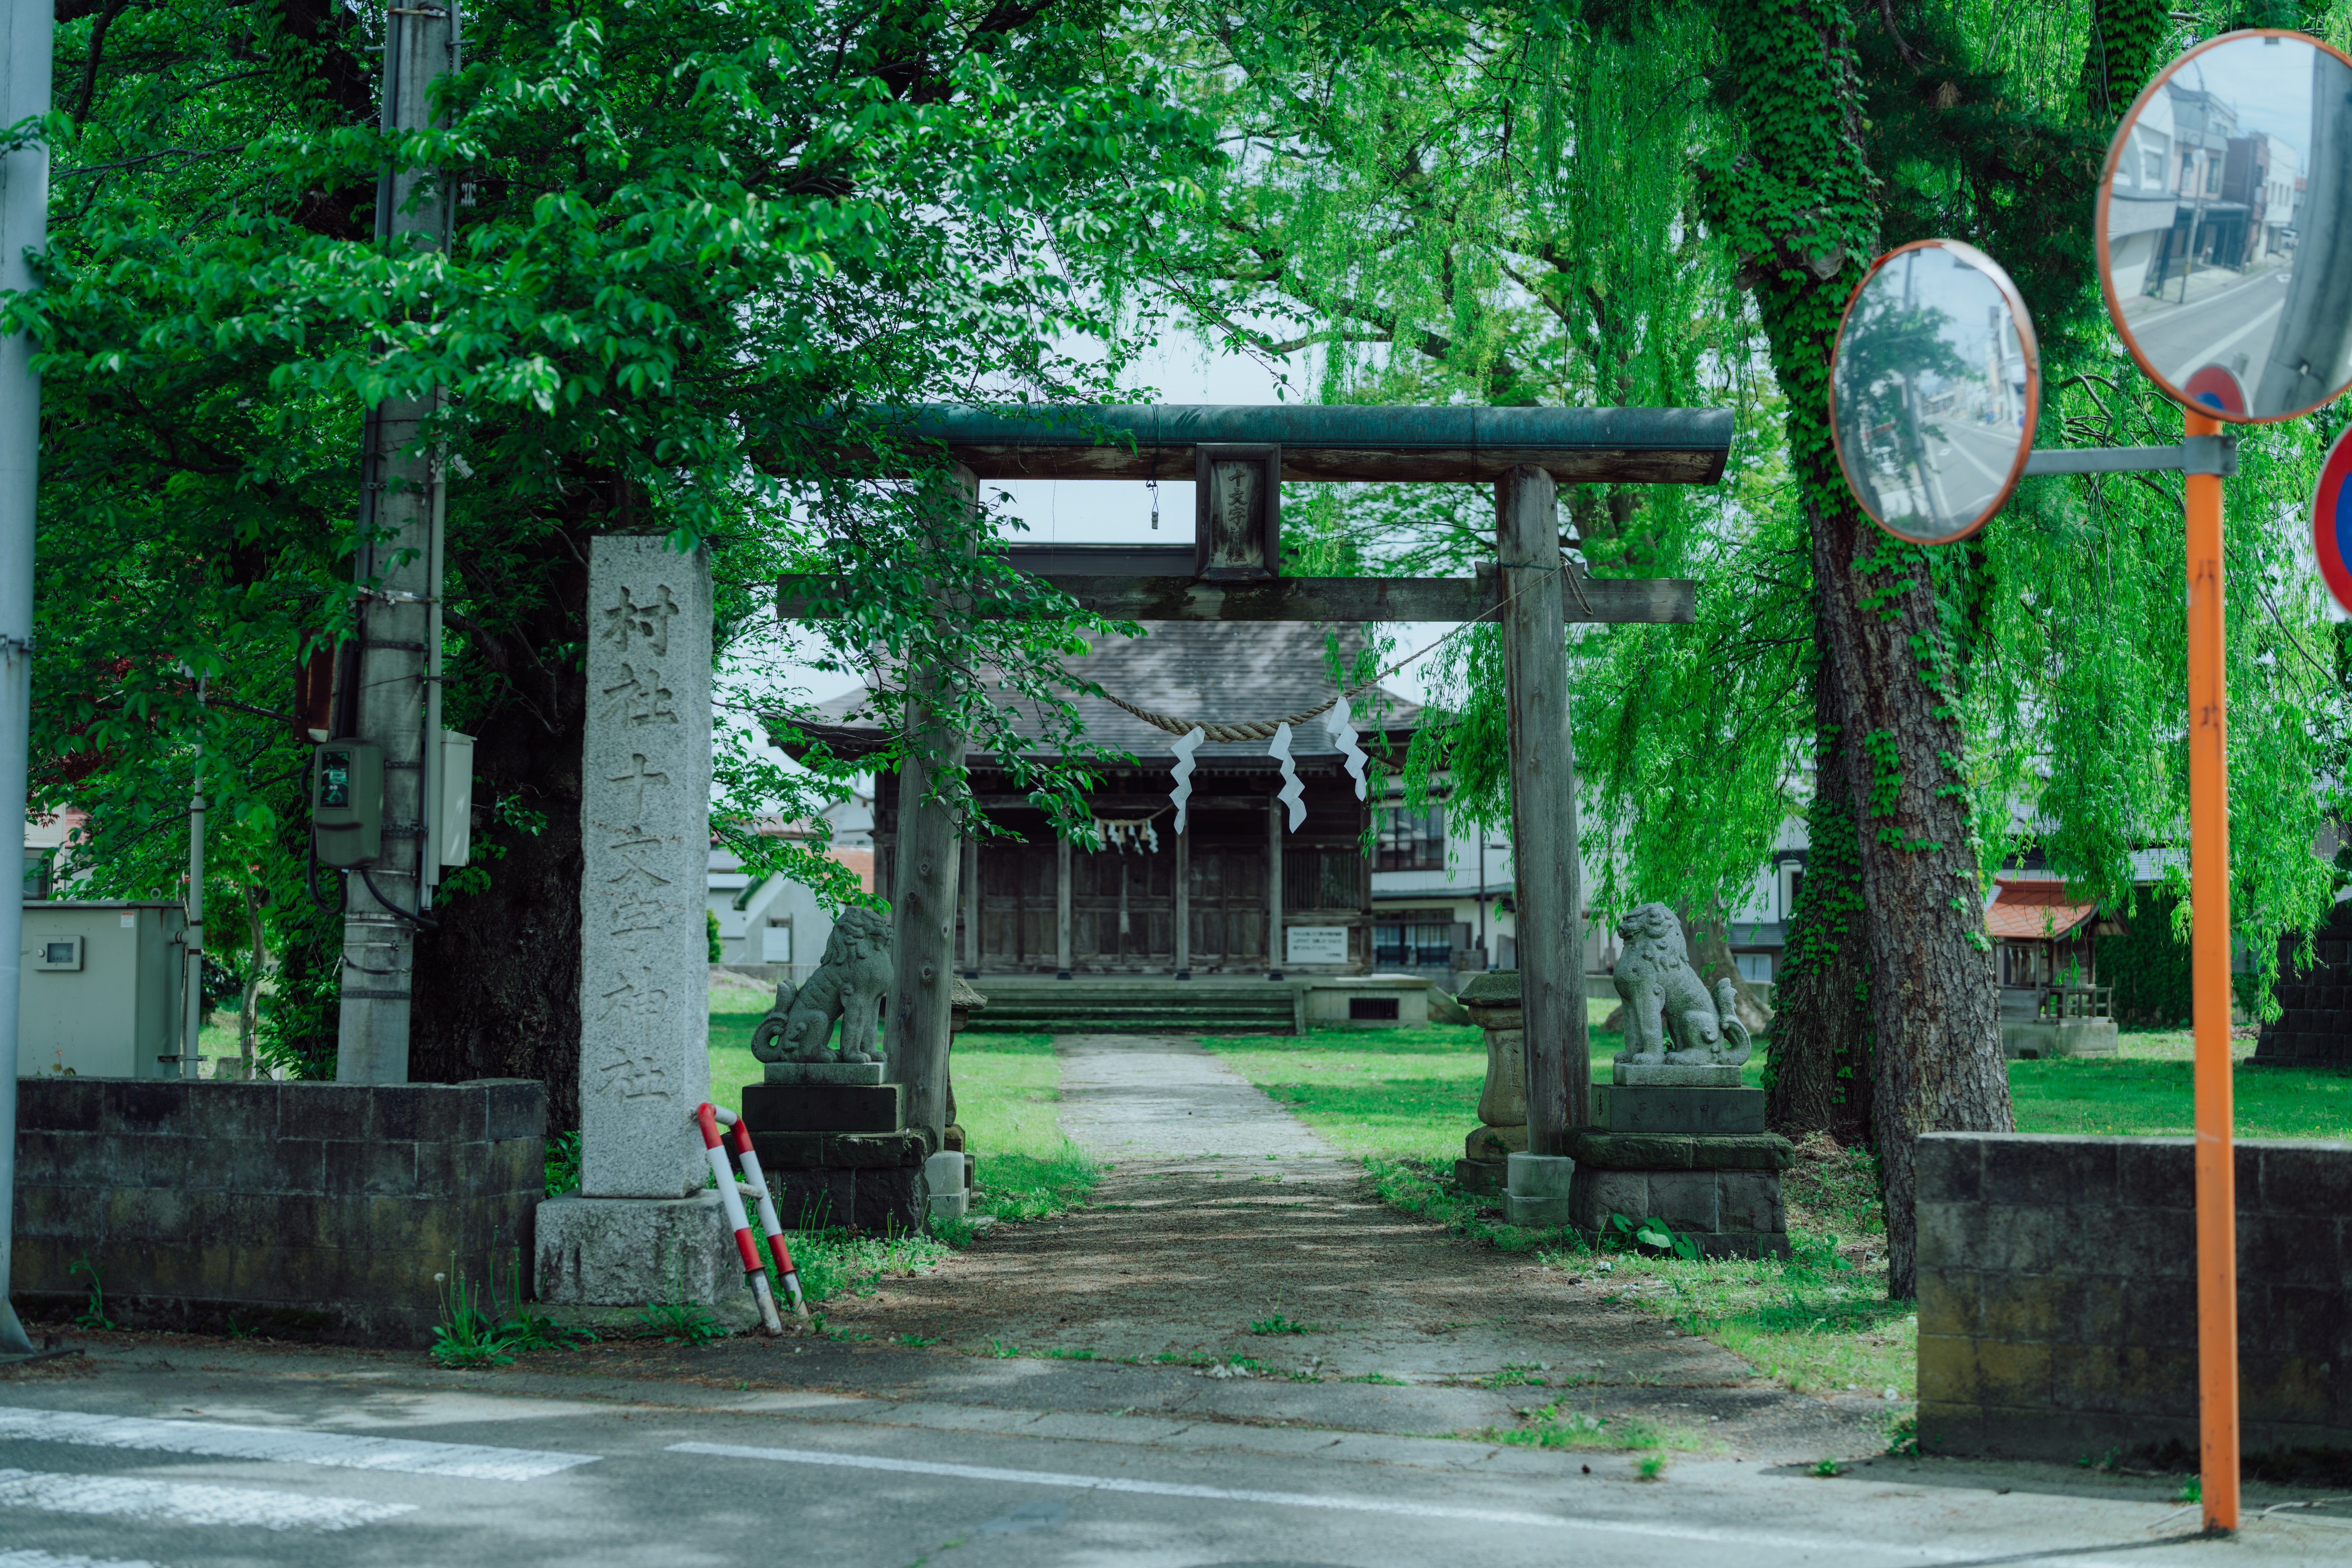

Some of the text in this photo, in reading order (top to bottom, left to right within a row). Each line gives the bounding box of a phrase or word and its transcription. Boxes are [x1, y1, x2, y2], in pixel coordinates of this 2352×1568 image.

[1225, 469, 1248, 563] 十文字神社
[597, 583, 679, 1103] 村社十文字神社
